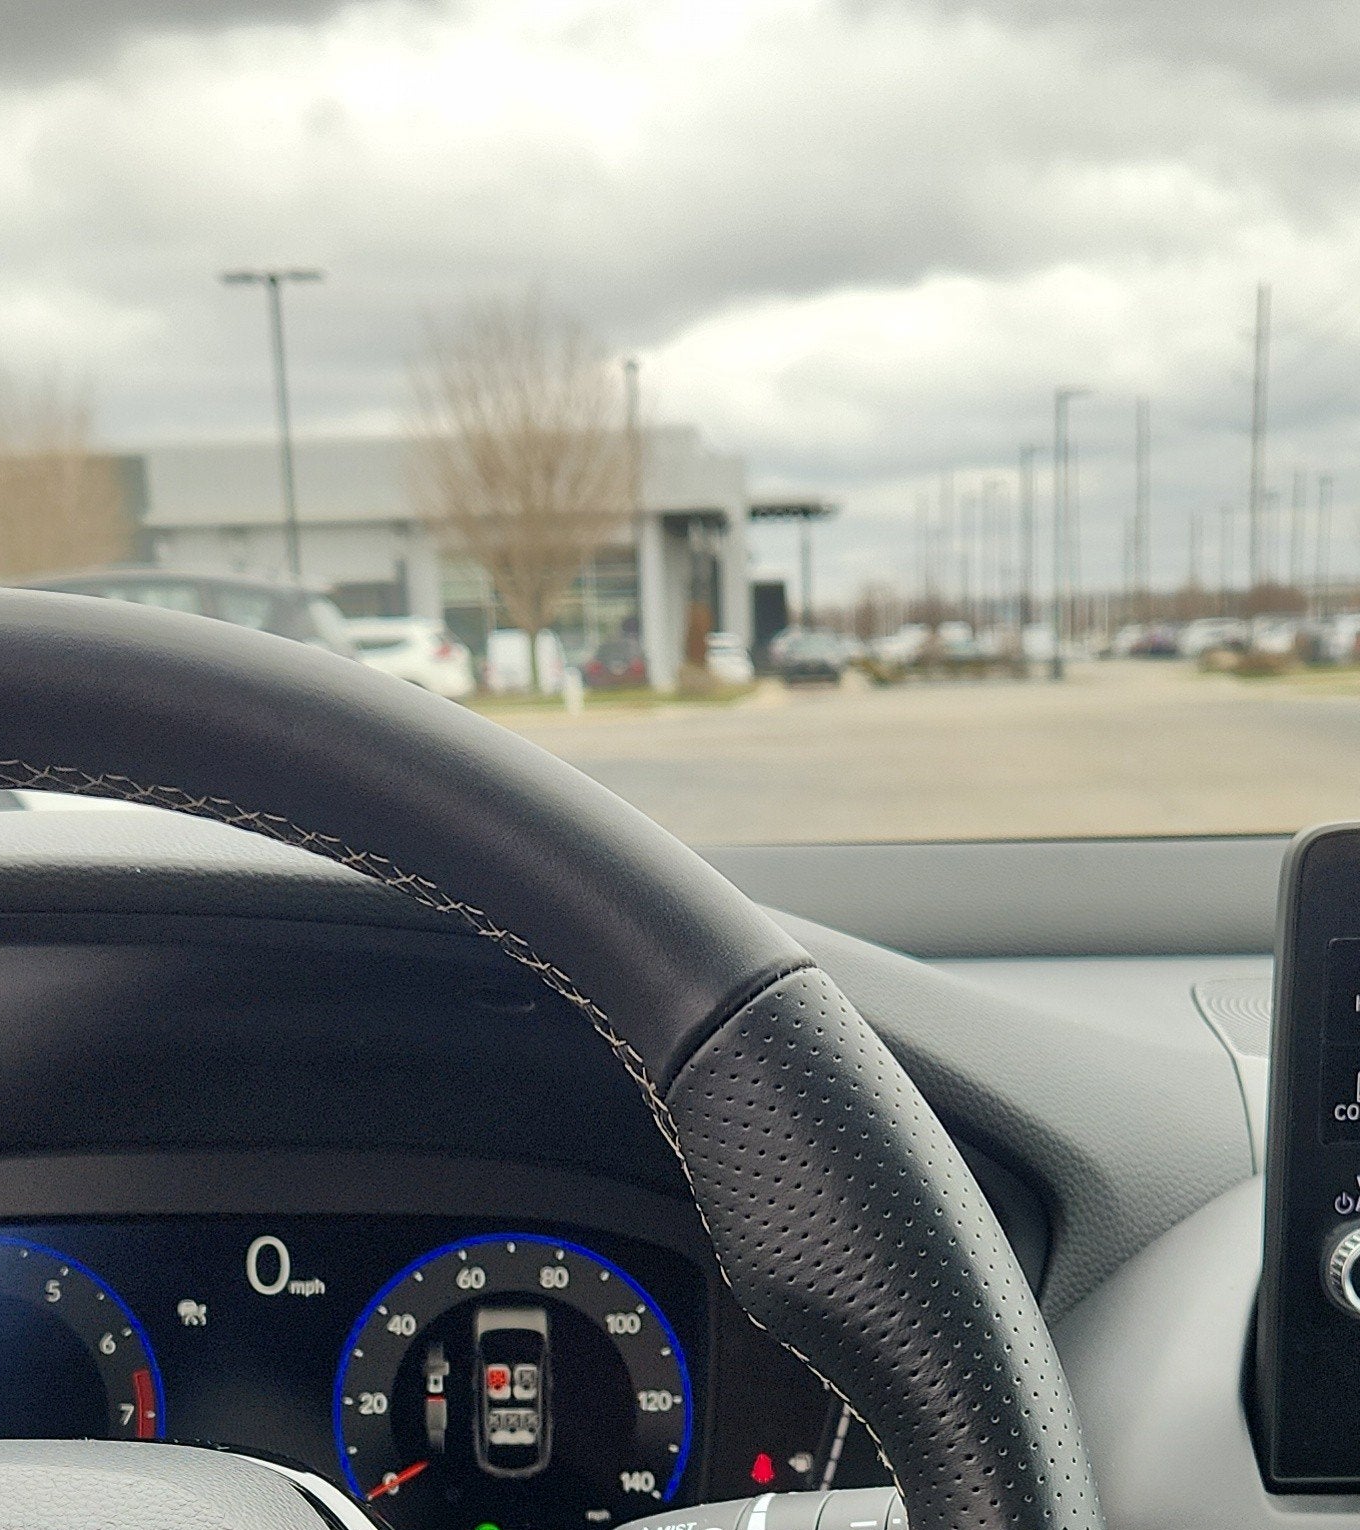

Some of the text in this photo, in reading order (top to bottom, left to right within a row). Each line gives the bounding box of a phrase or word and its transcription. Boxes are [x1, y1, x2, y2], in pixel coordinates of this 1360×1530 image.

[246, 1235, 326, 1297] 0 mph
[540, 1266, 569, 1289] 80
[456, 1267, 485, 1289] 60
[45, 1280, 61, 1303] 5
[387, 1313, 416, 1336] 40
[606, 1313, 641, 1336] 100
[99, 1332, 116, 1355] 6
[358, 1392, 388, 1415] 20
[638, 1390, 673, 1413] 120
[119, 1403, 135, 1425] 7
[619, 1470, 656, 1493] 140
